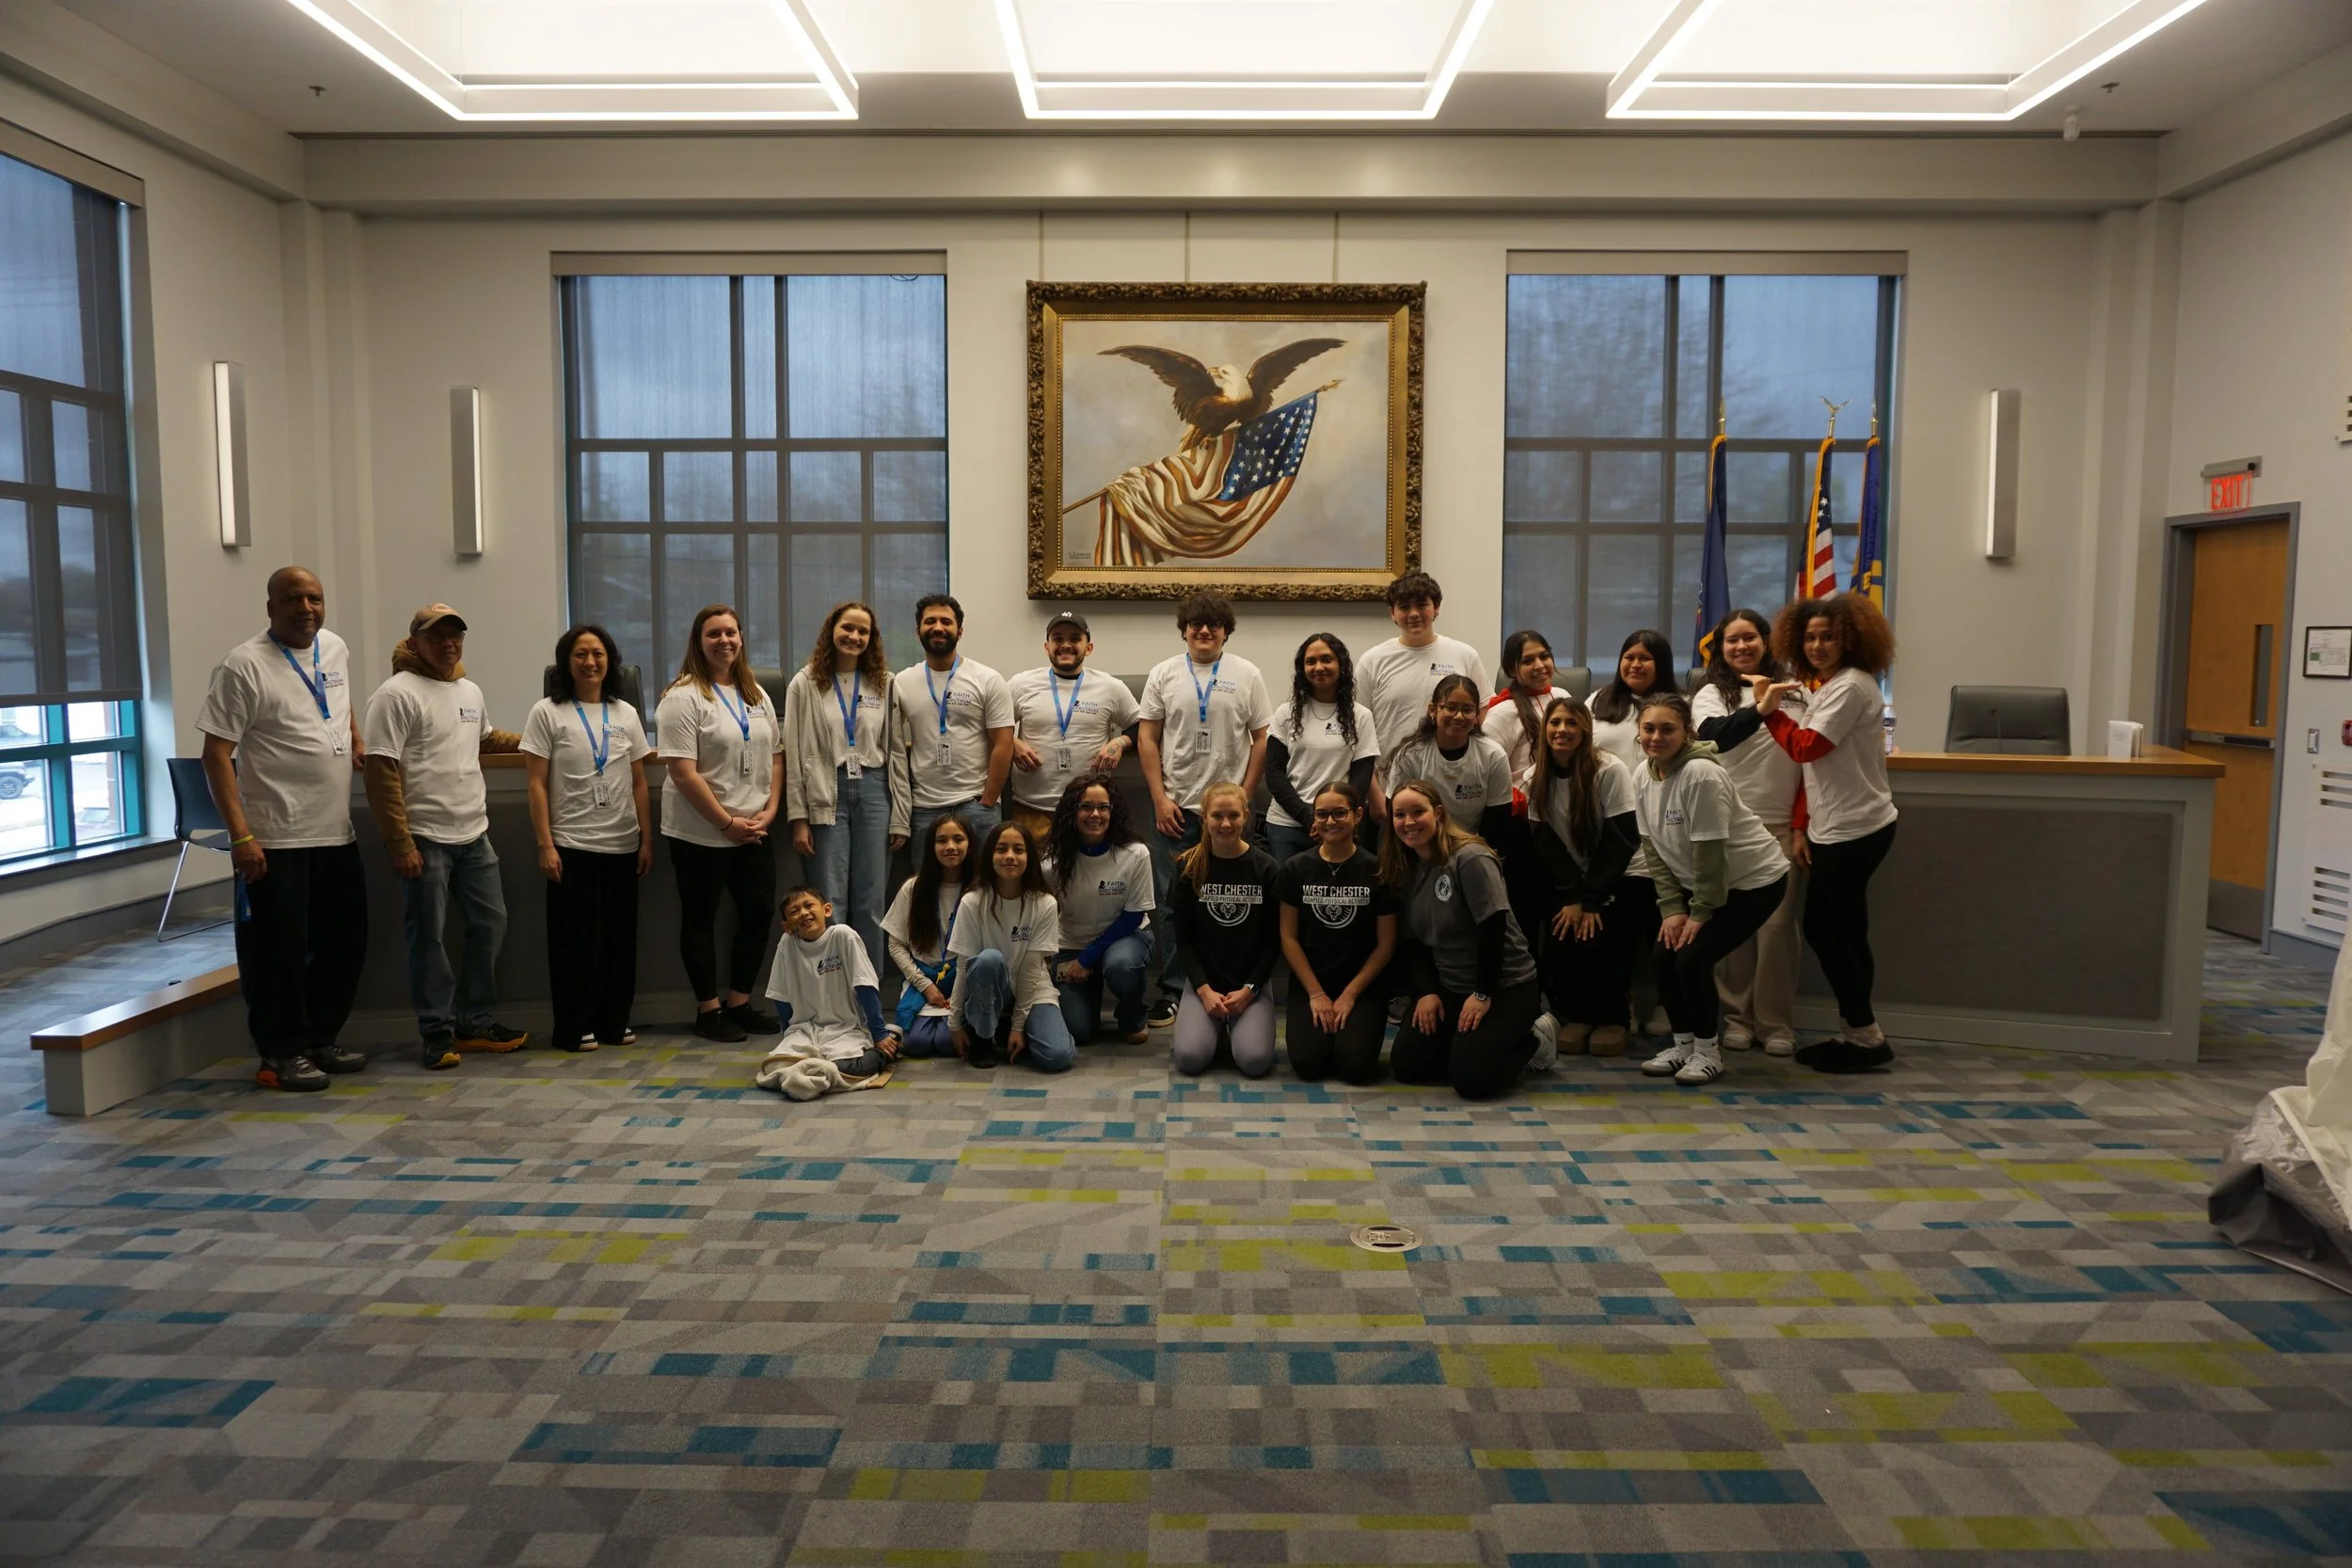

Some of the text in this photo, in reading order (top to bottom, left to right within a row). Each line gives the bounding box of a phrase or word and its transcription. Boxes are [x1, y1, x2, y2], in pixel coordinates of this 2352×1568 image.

[2211, 475, 2244, 510] EXIT
[1200, 883, 1263, 896] WEST CHESTER
[1302, 884, 1371, 898] WEST CHESTER
